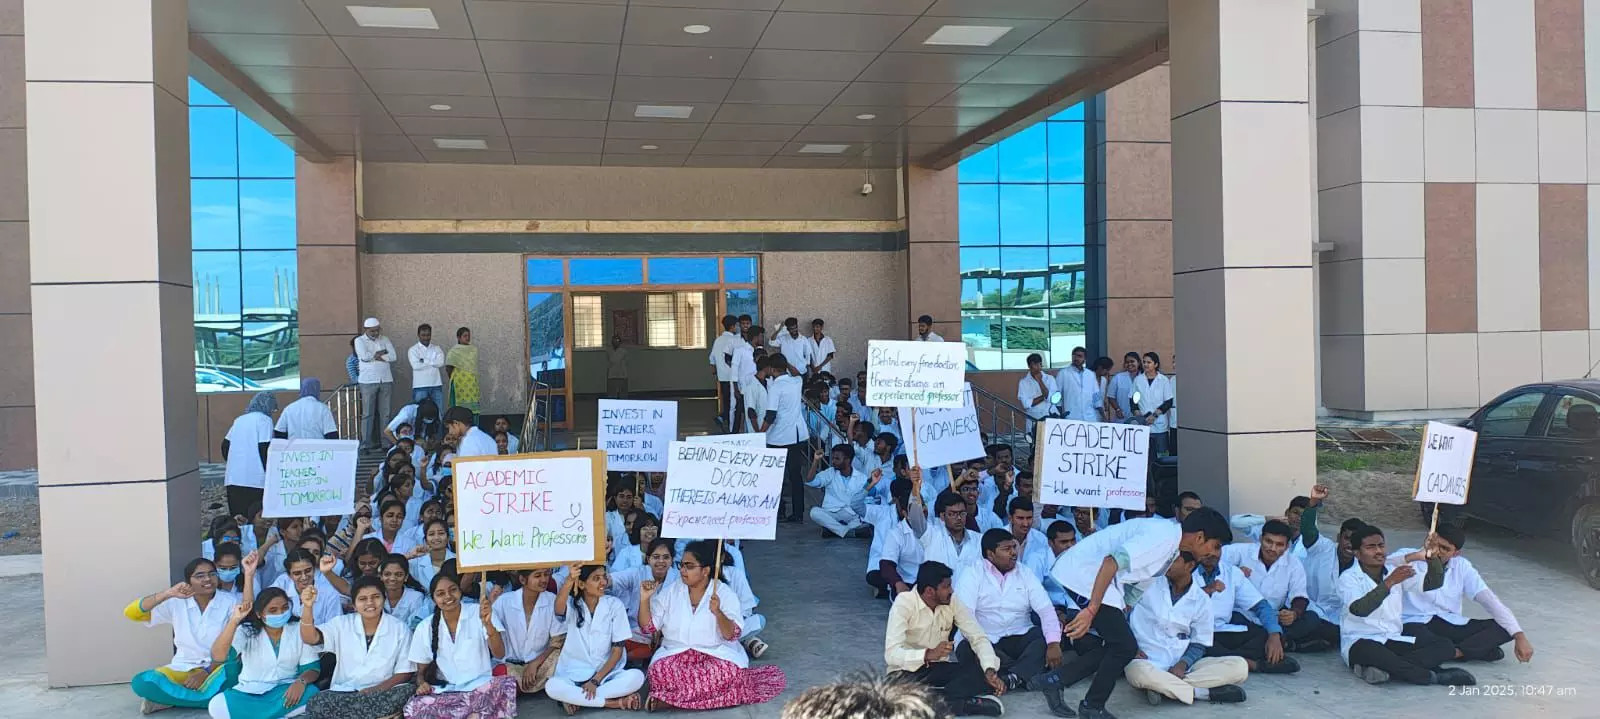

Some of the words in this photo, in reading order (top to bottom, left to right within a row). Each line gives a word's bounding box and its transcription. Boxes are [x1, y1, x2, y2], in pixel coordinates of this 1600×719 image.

[602, 408, 648, 420] INVEST
[652, 409, 663, 420] IN
[918, 414, 978, 444] CADAVERS
[1048, 423, 1143, 455] ACADEMIC
[606, 440, 636, 449] INVEST
[642, 440, 653, 449] IN
[280, 450, 315, 463] INVEST
[319, 449, 334, 461] IN
[678, 446, 716, 462] BEHIND
[718, 450, 758, 467] EVERY
[759, 455, 786, 468] FINE
[1058, 452, 1127, 480] STRIKE
[280, 479, 310, 488] INVEST
[464, 468, 547, 490] ACADEMIC
[710, 467, 759, 488] DOCTOR
[1074, 484, 1101, 496] want
[480, 490, 554, 515] STRIKE
[716, 493, 759, 509] ALWAYS
[758, 493, 780, 510] AN
[463, 530, 484, 551] We
[491, 529, 526, 549] Want
